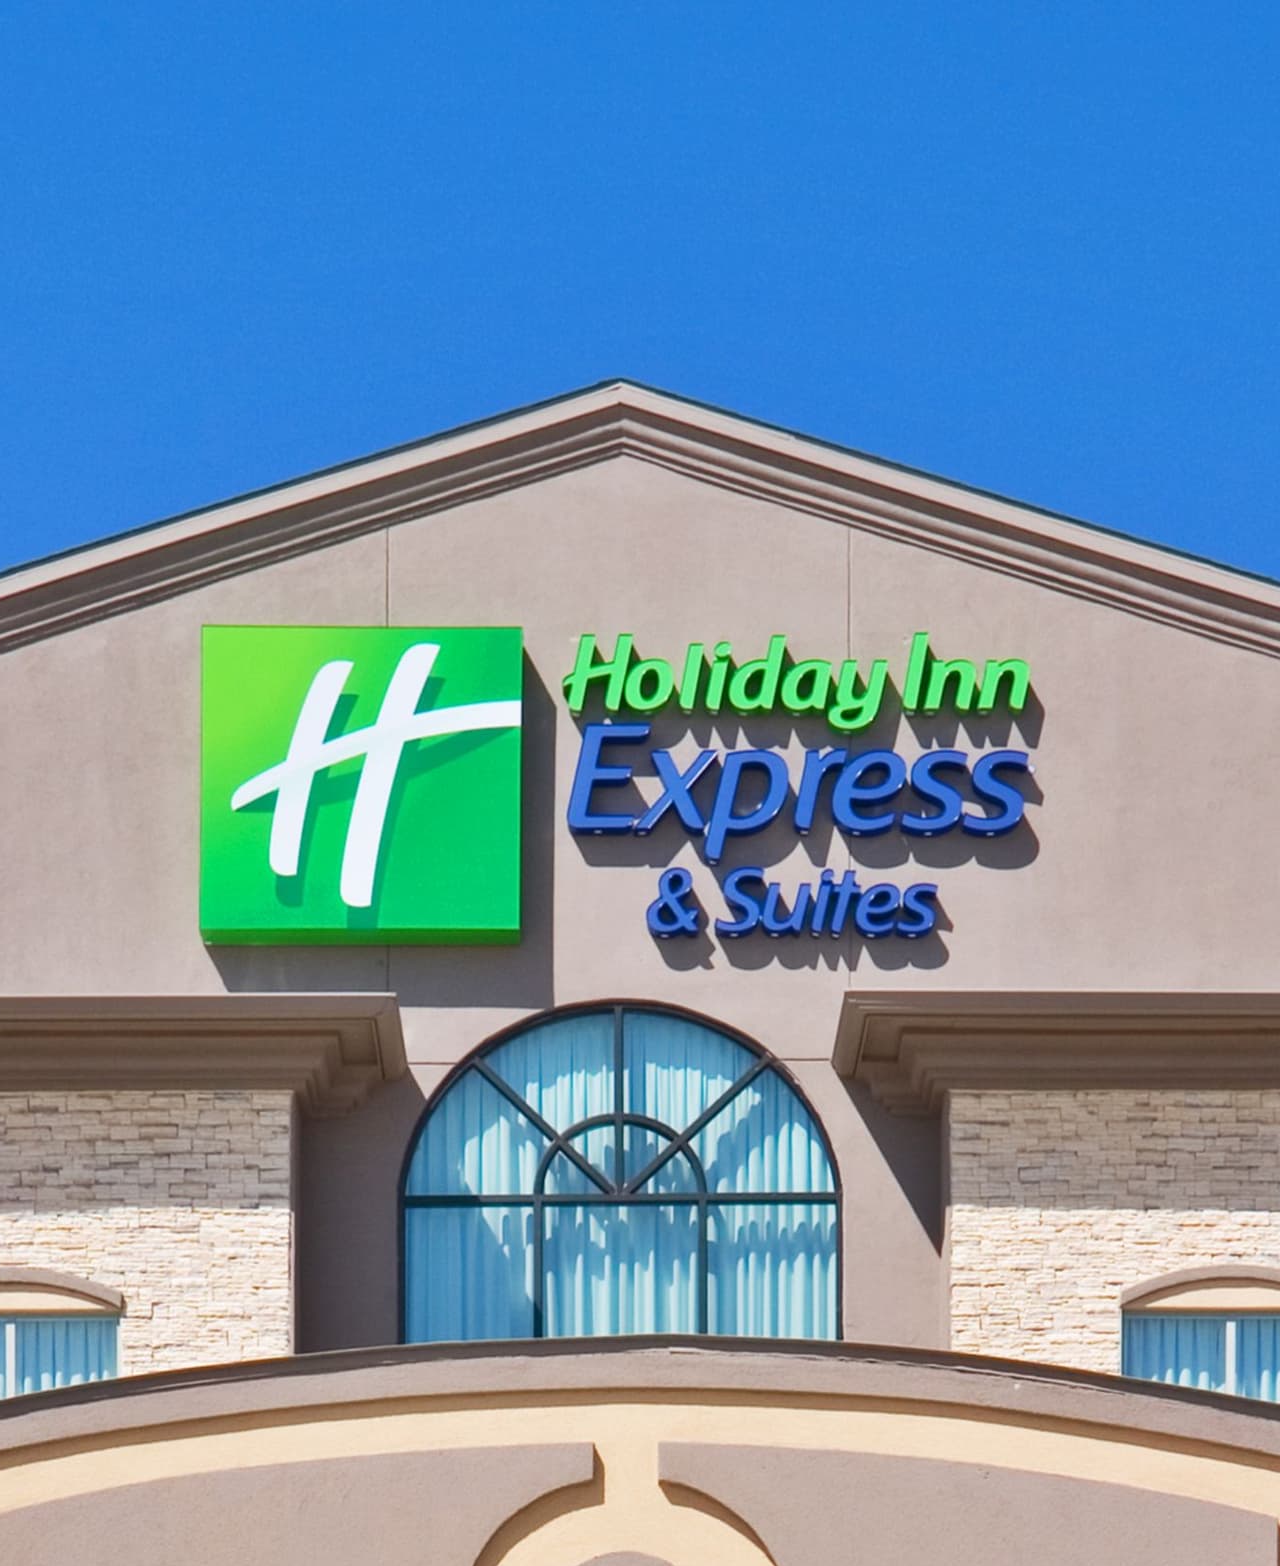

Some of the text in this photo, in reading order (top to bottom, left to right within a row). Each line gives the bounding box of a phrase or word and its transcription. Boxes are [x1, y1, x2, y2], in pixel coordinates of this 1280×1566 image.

[562, 632, 1031, 734] Holiday Inn
[231, 642, 521, 908] H
[567, 722, 1030, 864] Express
[646, 866, 939, 938] & Suites
